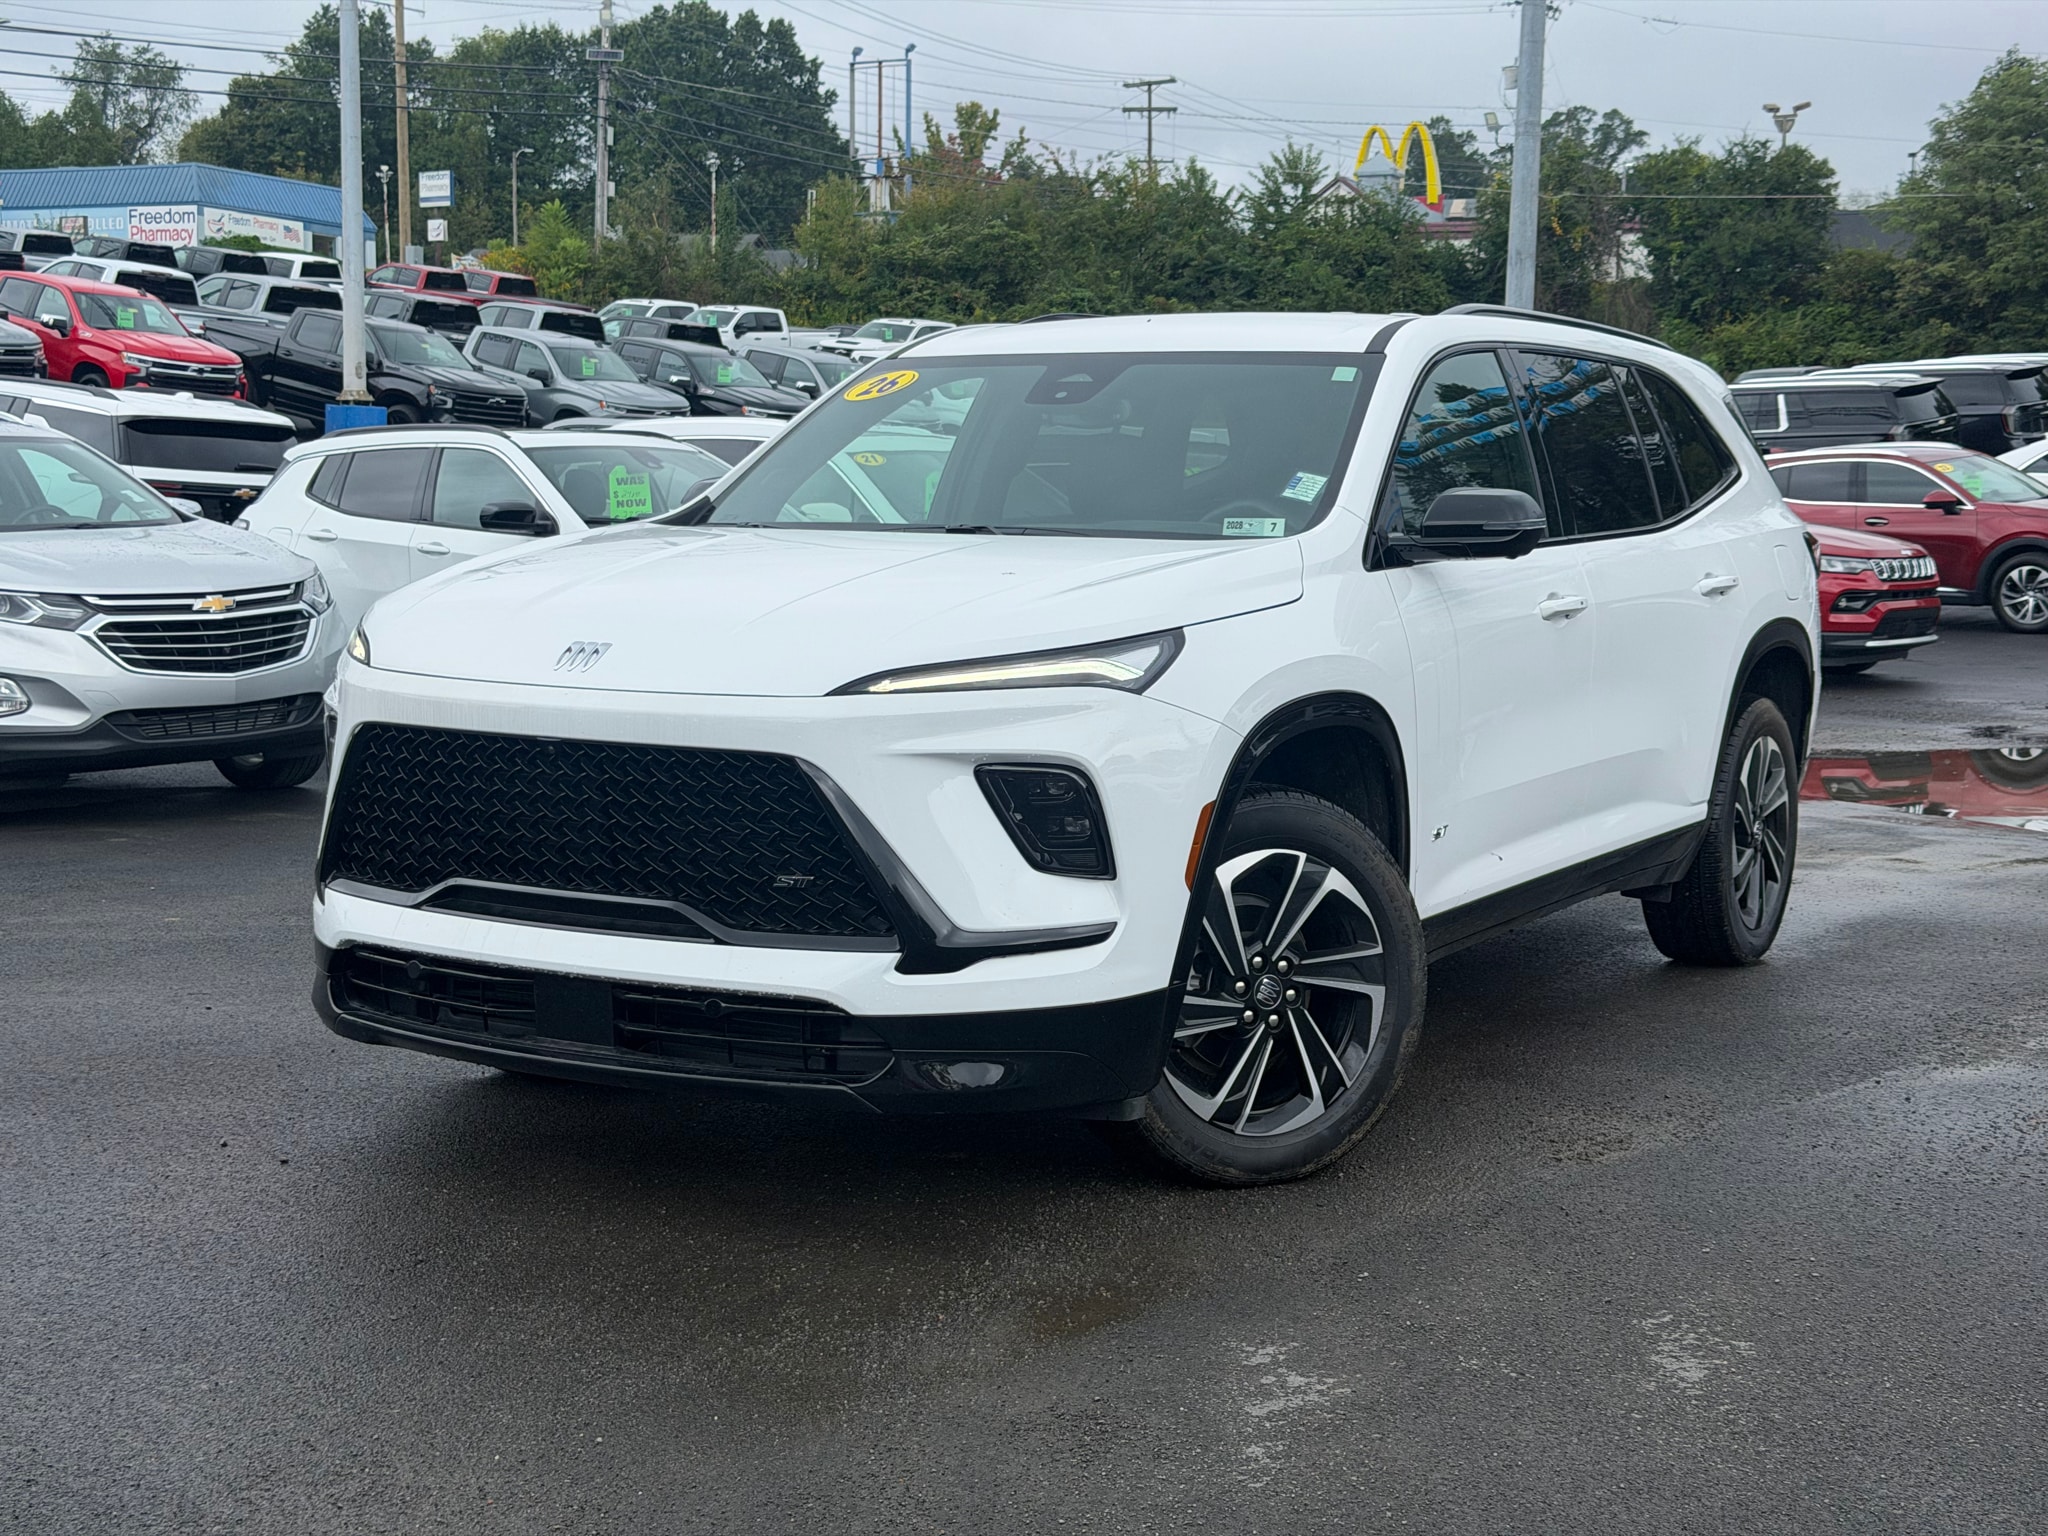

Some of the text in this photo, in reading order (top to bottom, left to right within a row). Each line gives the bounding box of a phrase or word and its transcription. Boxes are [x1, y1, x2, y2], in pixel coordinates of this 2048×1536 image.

[128, 207, 196, 225] Freedom
[130, 225, 194, 245] Pharmacy
[855, 372, 907, 398] 26
[860, 454, 879, 464] 21
[615, 475, 645, 486] WAS
[616, 498, 647, 509] NOW
[1226, 520, 1244, 530] 2028
[1270, 522, 1277, 532] 7
[773, 874, 814, 888] ST
